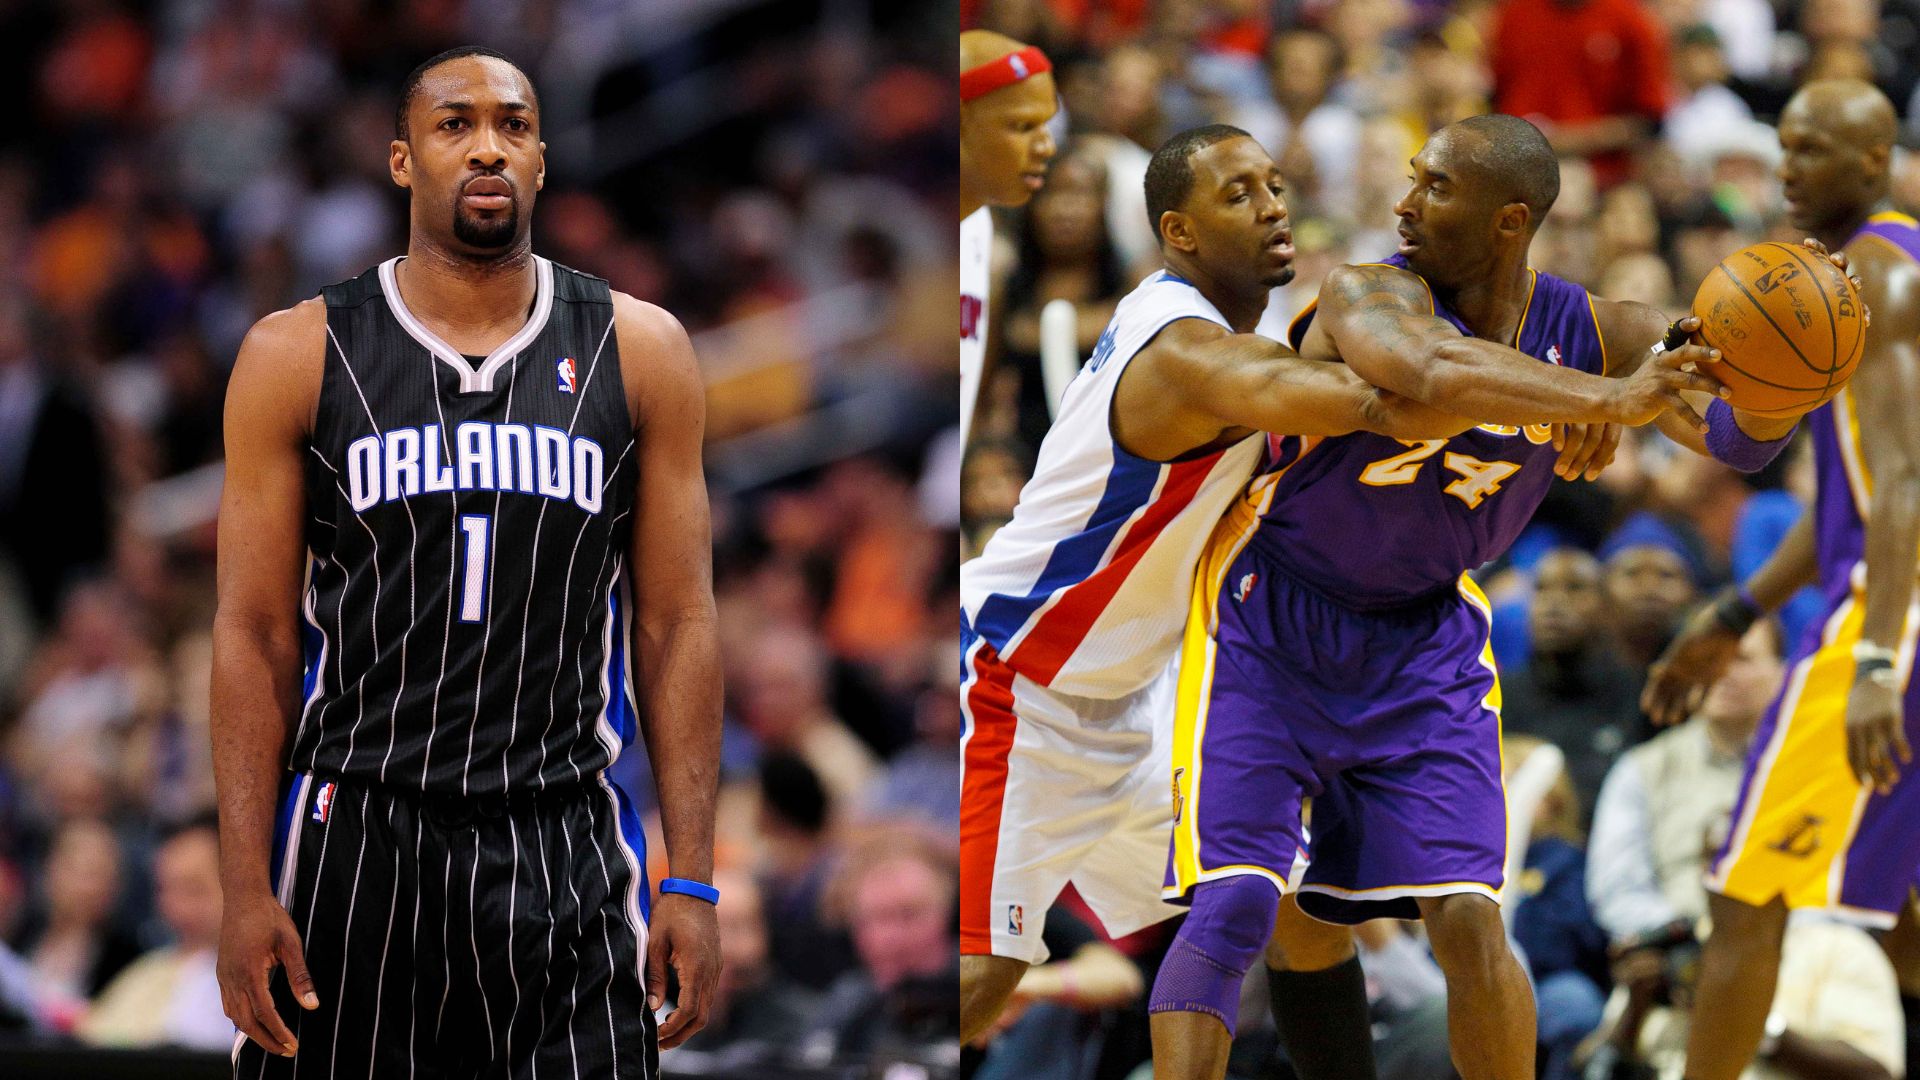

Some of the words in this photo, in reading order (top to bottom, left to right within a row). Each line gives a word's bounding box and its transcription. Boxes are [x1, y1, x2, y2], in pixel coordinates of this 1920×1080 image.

[347, 420, 603, 515] ORLANDO
[1358, 438, 1522, 511] 24
[457, 513, 491, 624] 1
